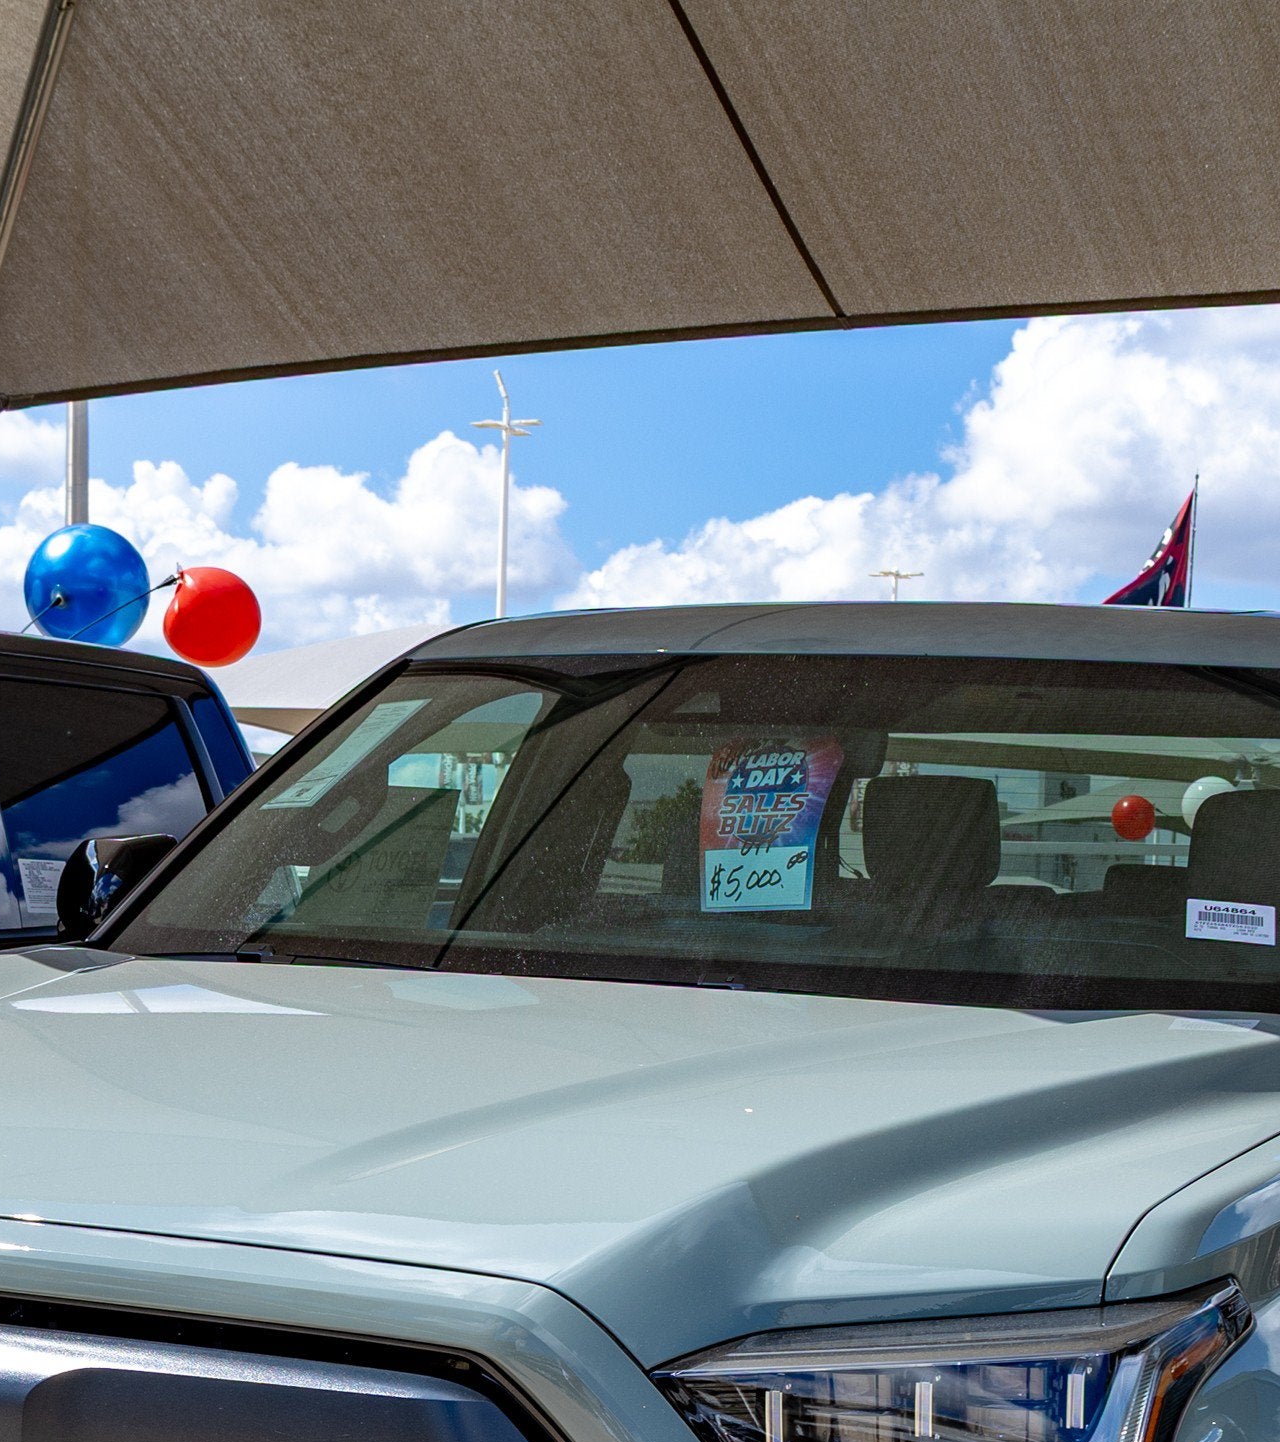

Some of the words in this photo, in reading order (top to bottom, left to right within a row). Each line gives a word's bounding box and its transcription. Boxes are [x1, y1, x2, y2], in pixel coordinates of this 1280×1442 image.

[745, 752, 805, 769] LABOR
[745, 767, 794, 788] DAY
[719, 793, 810, 815] SALES
[718, 813, 798, 837] BLITZ
